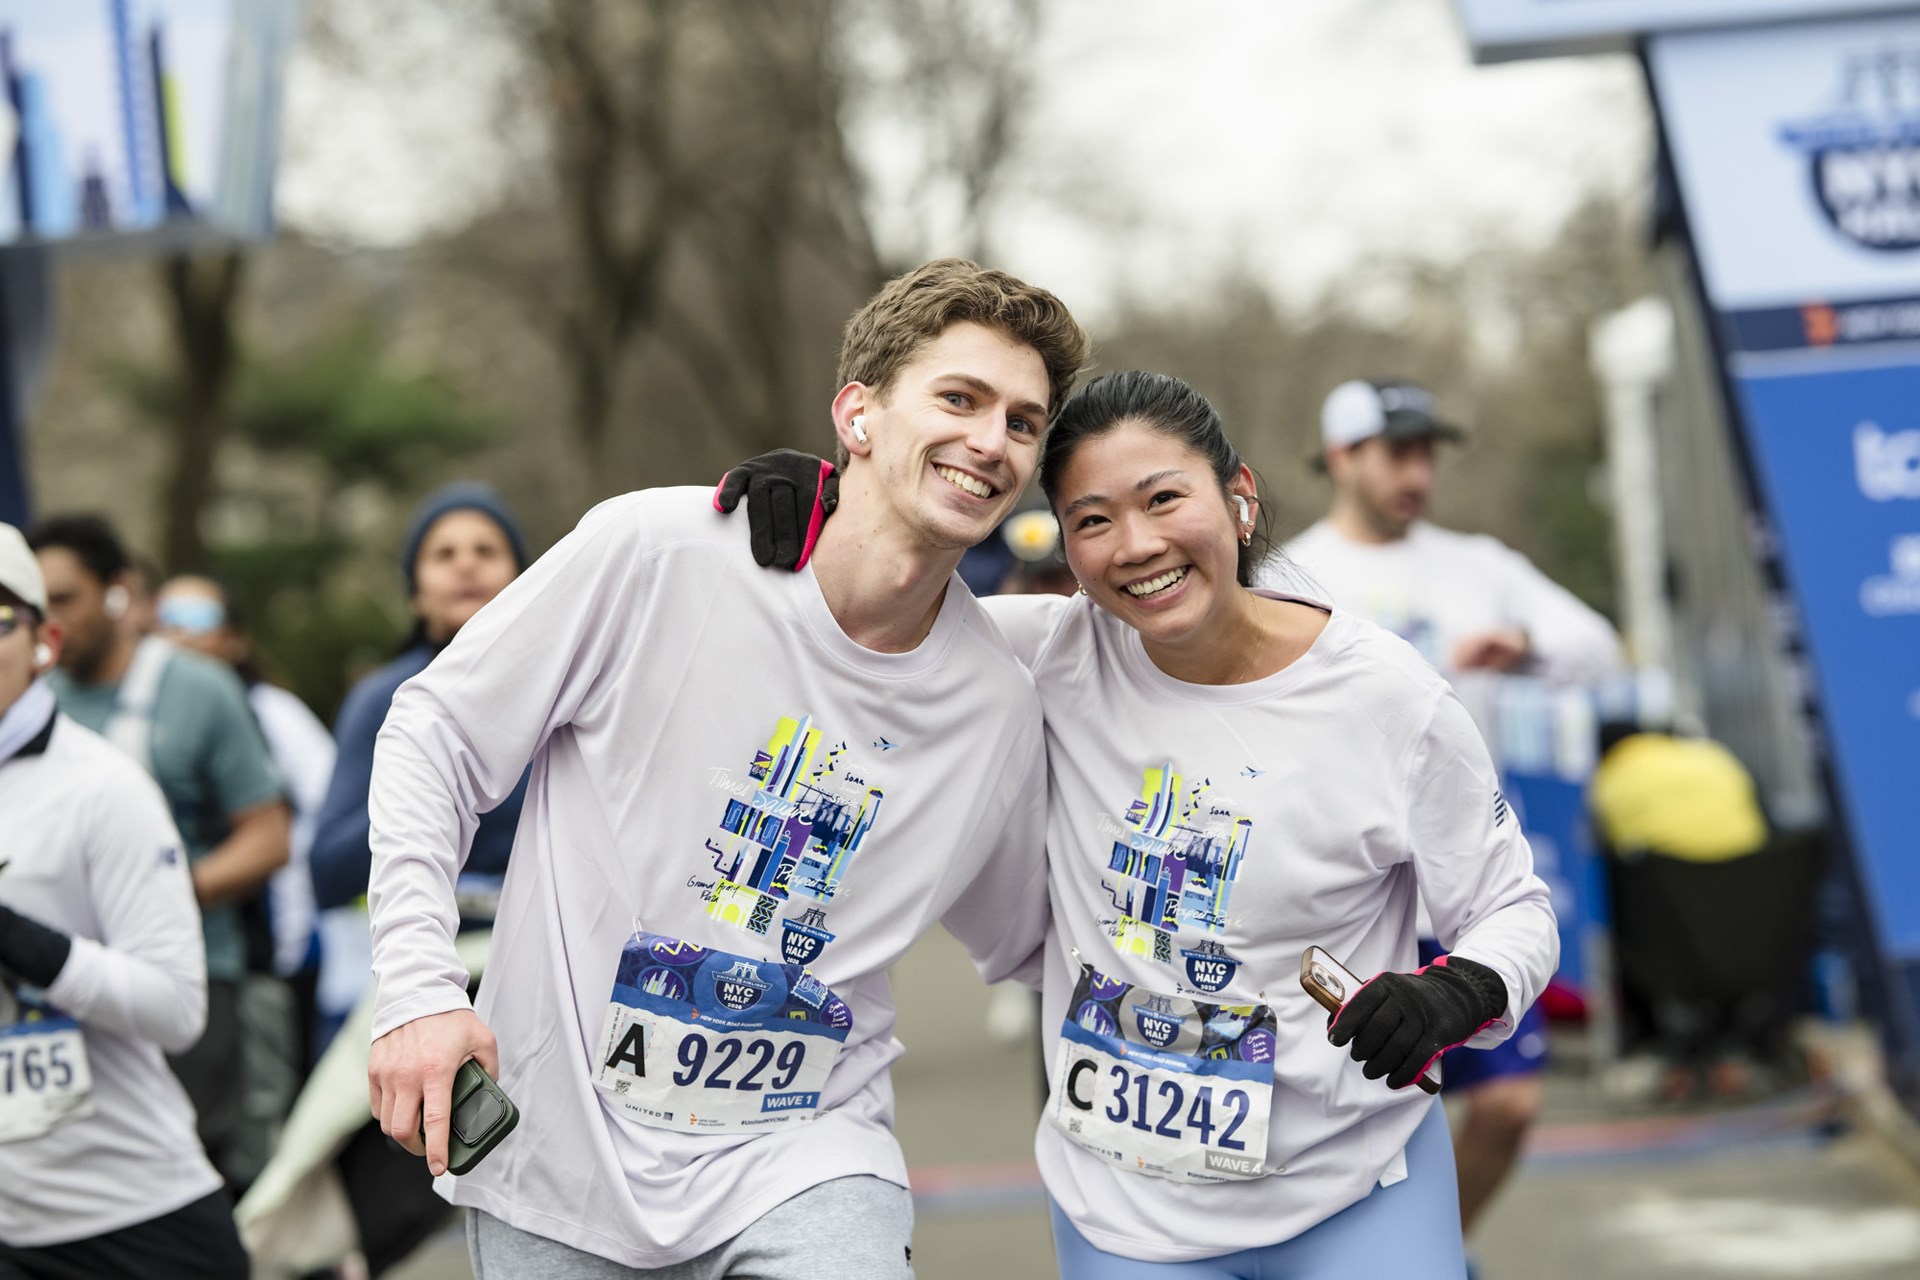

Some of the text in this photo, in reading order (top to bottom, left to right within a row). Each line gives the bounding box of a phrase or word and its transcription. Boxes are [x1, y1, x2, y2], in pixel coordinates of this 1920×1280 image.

[786, 932, 816, 950] NYC
[786, 944, 810, 959] HALF
[1194, 960, 1227, 976] NYC
[1196, 972, 1224, 984] HALF
[724, 983, 754, 998] NYC
[724, 993, 750, 1004] HALF
[1144, 1017, 1172, 1034] NYC
[1145, 1029, 1169, 1040] HALF
[606, 1022, 646, 1078] A
[672, 1034, 806, 1091] 9229
[1068, 1058, 1098, 1110] C
[767, 1094, 812, 1108] WAVE 1
[1106, 1065, 1250, 1150] 31242
[625, 1104, 662, 1118] UNITED
[1208, 1154, 1250, 1173] WAVE
